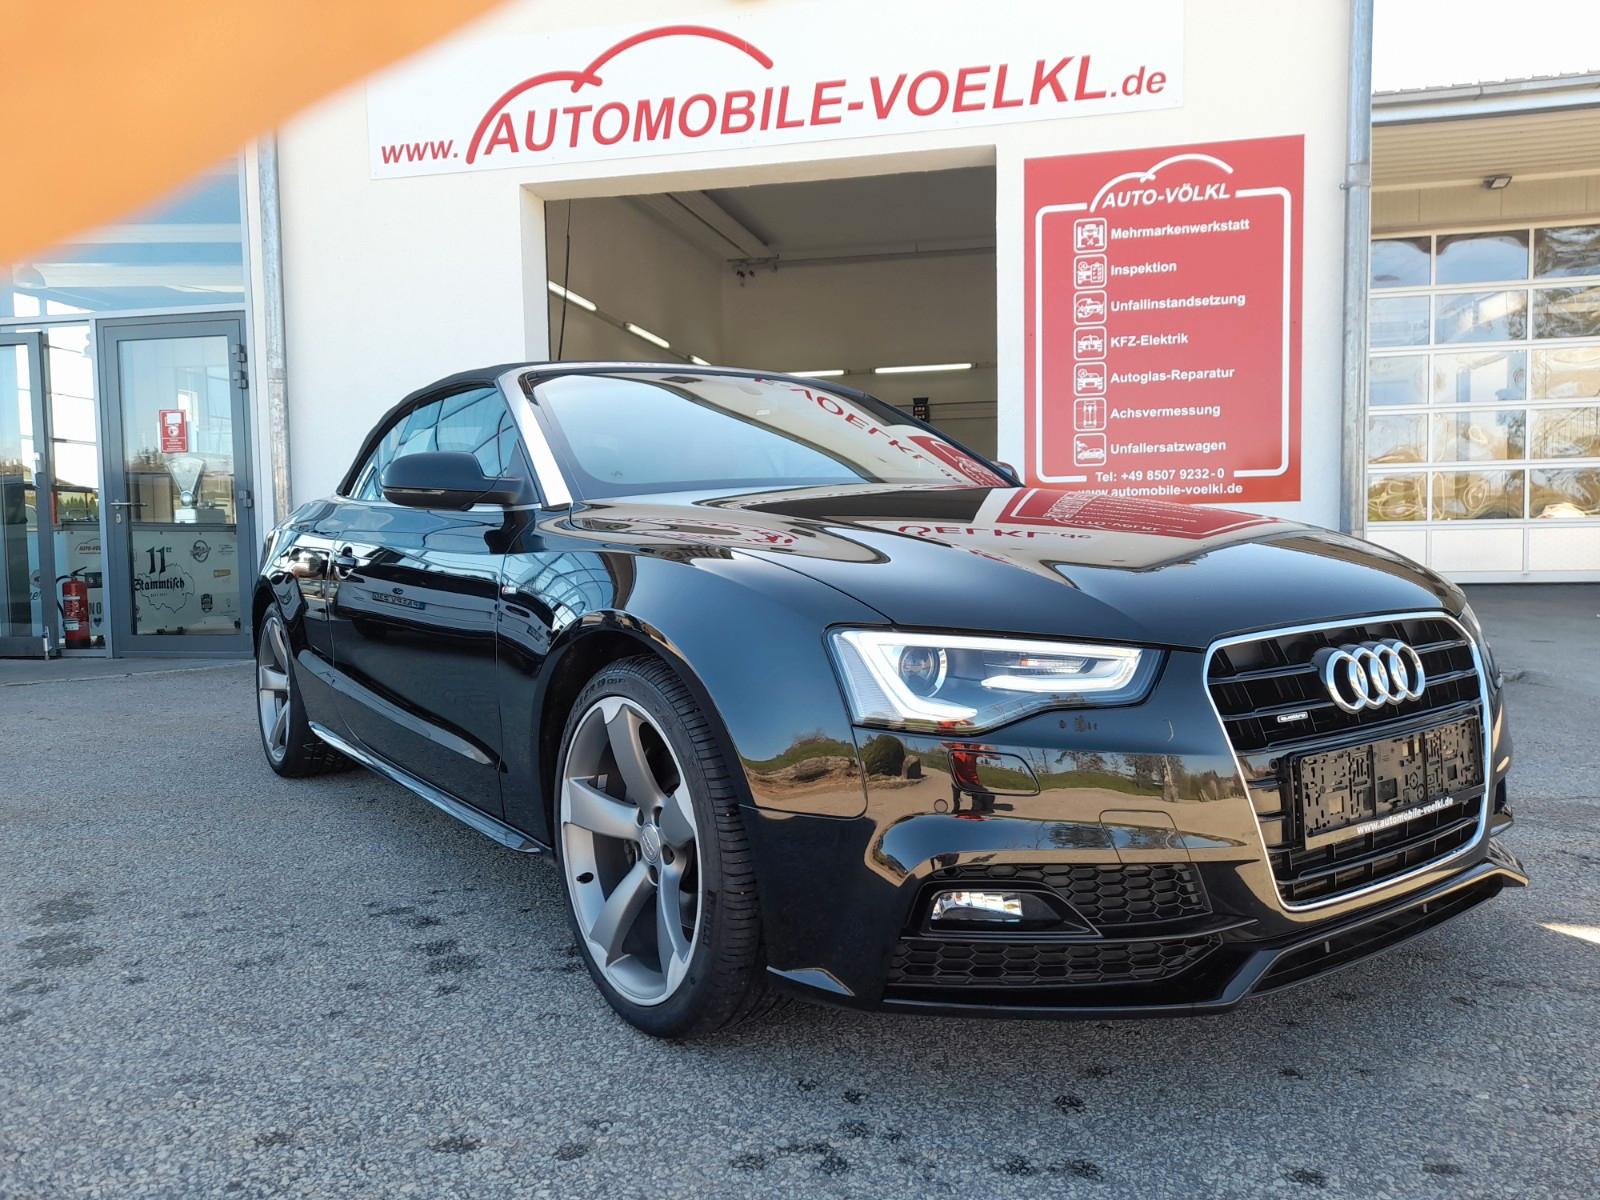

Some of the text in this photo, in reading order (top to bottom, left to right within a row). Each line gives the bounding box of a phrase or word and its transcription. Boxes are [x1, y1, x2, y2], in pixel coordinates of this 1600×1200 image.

[1101, 182, 1231, 209] AUTO-VÖLKL
[1110, 218, 1250, 240] Mehrmarkenwerkstatt
[1110, 261, 1177, 277] Inspektion
[1110, 293, 1246, 312] Unfallinstandsetzung
[1110, 333, 1189, 348] KFZ-Elektrik
[1110, 367, 1235, 385] Autoglas-Reparatur
[1110, 404, 1221, 420] Achsvermessung
[1110, 440, 1227, 455] Unfallersatzwagen
[1095, 471, 1117, 483] Tel:
[1121, 470, 1144, 482] +49
[1146, 469, 1176, 481] 8507
[1078, 483, 1243, 498] wautomobile-voelkl.de
[1356, 796, 1454, 835] www.automobile-voelkl.de
